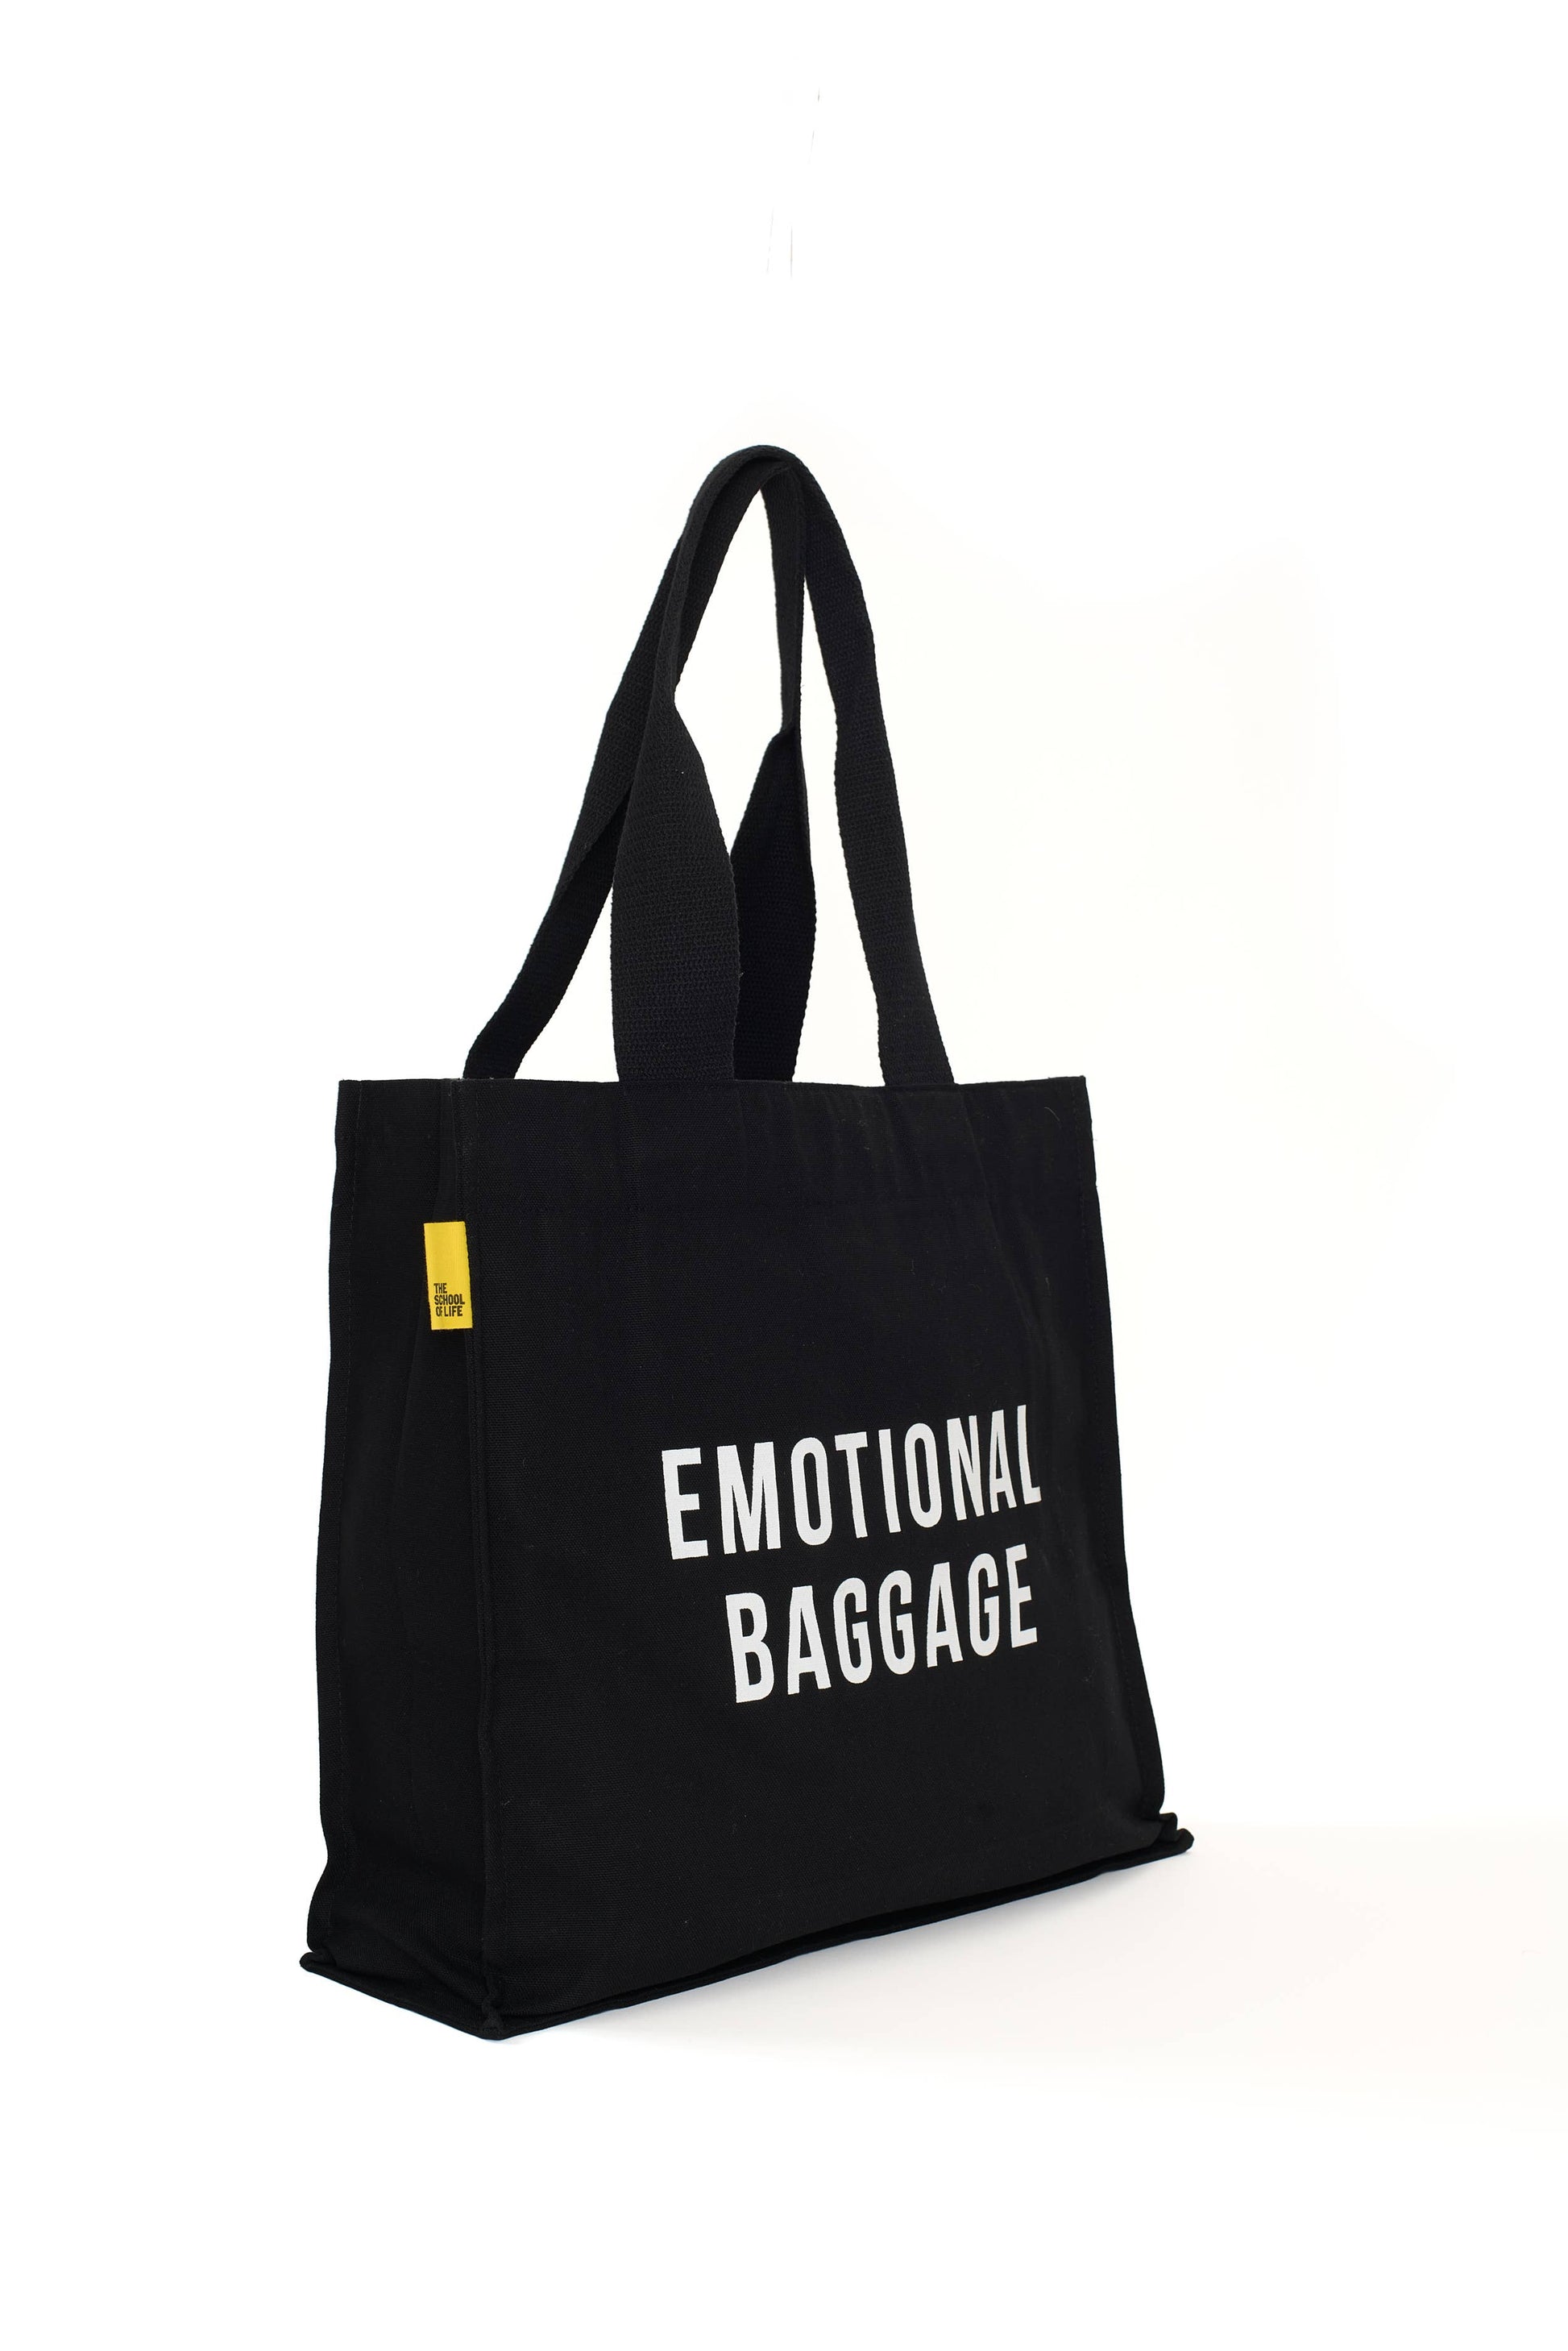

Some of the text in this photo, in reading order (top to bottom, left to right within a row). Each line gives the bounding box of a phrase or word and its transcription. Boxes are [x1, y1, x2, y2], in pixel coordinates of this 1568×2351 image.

[433, 1283, 447, 1294] THE
[434, 1294, 465, 1305] SCHOOL
[436, 1306, 463, 1317] OF LIFE
[662, 1405, 1041, 1560] EMOTIONAL
[725, 1544, 1037, 1703] BAGGAGE
